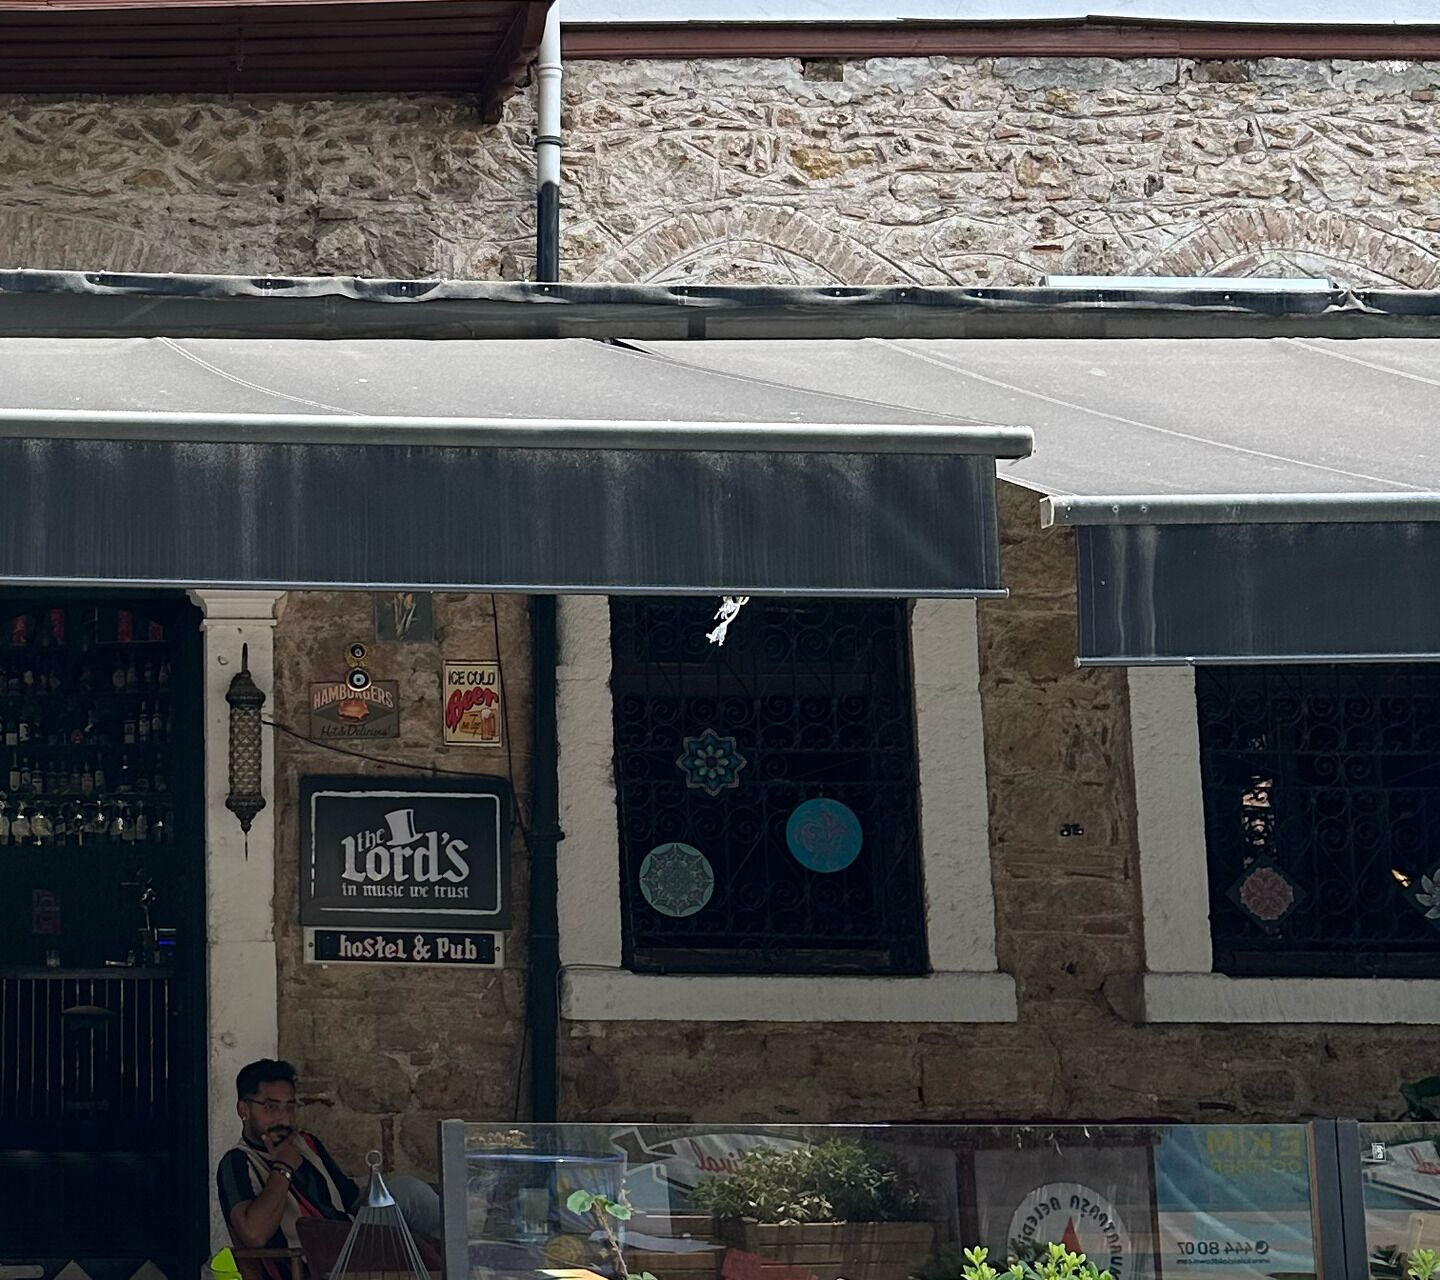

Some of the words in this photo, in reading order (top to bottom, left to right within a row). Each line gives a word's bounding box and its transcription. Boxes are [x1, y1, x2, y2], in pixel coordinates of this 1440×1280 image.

[448, 671, 465, 685] ICE
[467, 671, 495, 685] COLD
[446, 686, 499, 734] Beer
[358, 827, 386, 852] the
[342, 883, 357, 897] in
[363, 885, 404, 897] music
[410, 886, 429, 898] we
[434, 885, 469, 899] trust
[413, 934, 431, 960] &
[437, 936, 477, 960] Pub
